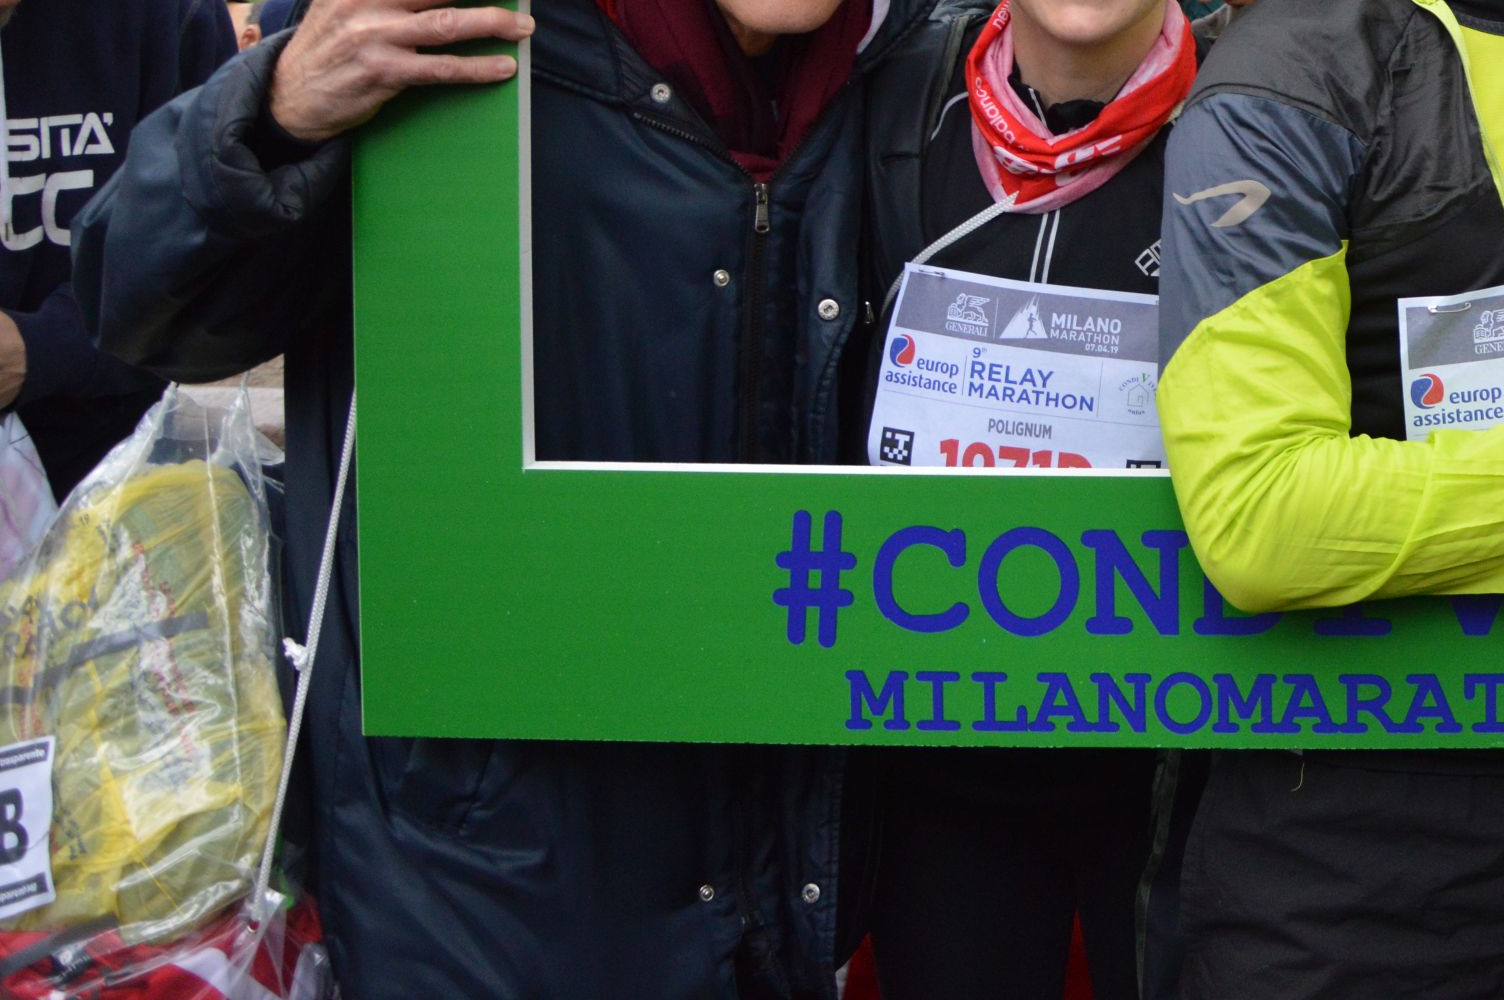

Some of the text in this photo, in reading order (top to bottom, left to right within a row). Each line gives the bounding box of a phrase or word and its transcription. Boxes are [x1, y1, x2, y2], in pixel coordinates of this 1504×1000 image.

[945, 321, 988, 337] GENERALI
[1051, 312, 1122, 333] MILANO
[1050, 328, 1120, 345] MARATHON
[1085, 343, 1119, 354] 07.04.19
[917, 357, 959, 378] europ
[970, 360, 1054, 389] RELAY
[885, 369, 957, 395] assistance
[967, 382, 1094, 412] MARATHON
[1449, 387, 1502, 404] europ
[1413, 404, 1504, 427] assistance
[988, 418, 1052, 440] POLIGNUM
